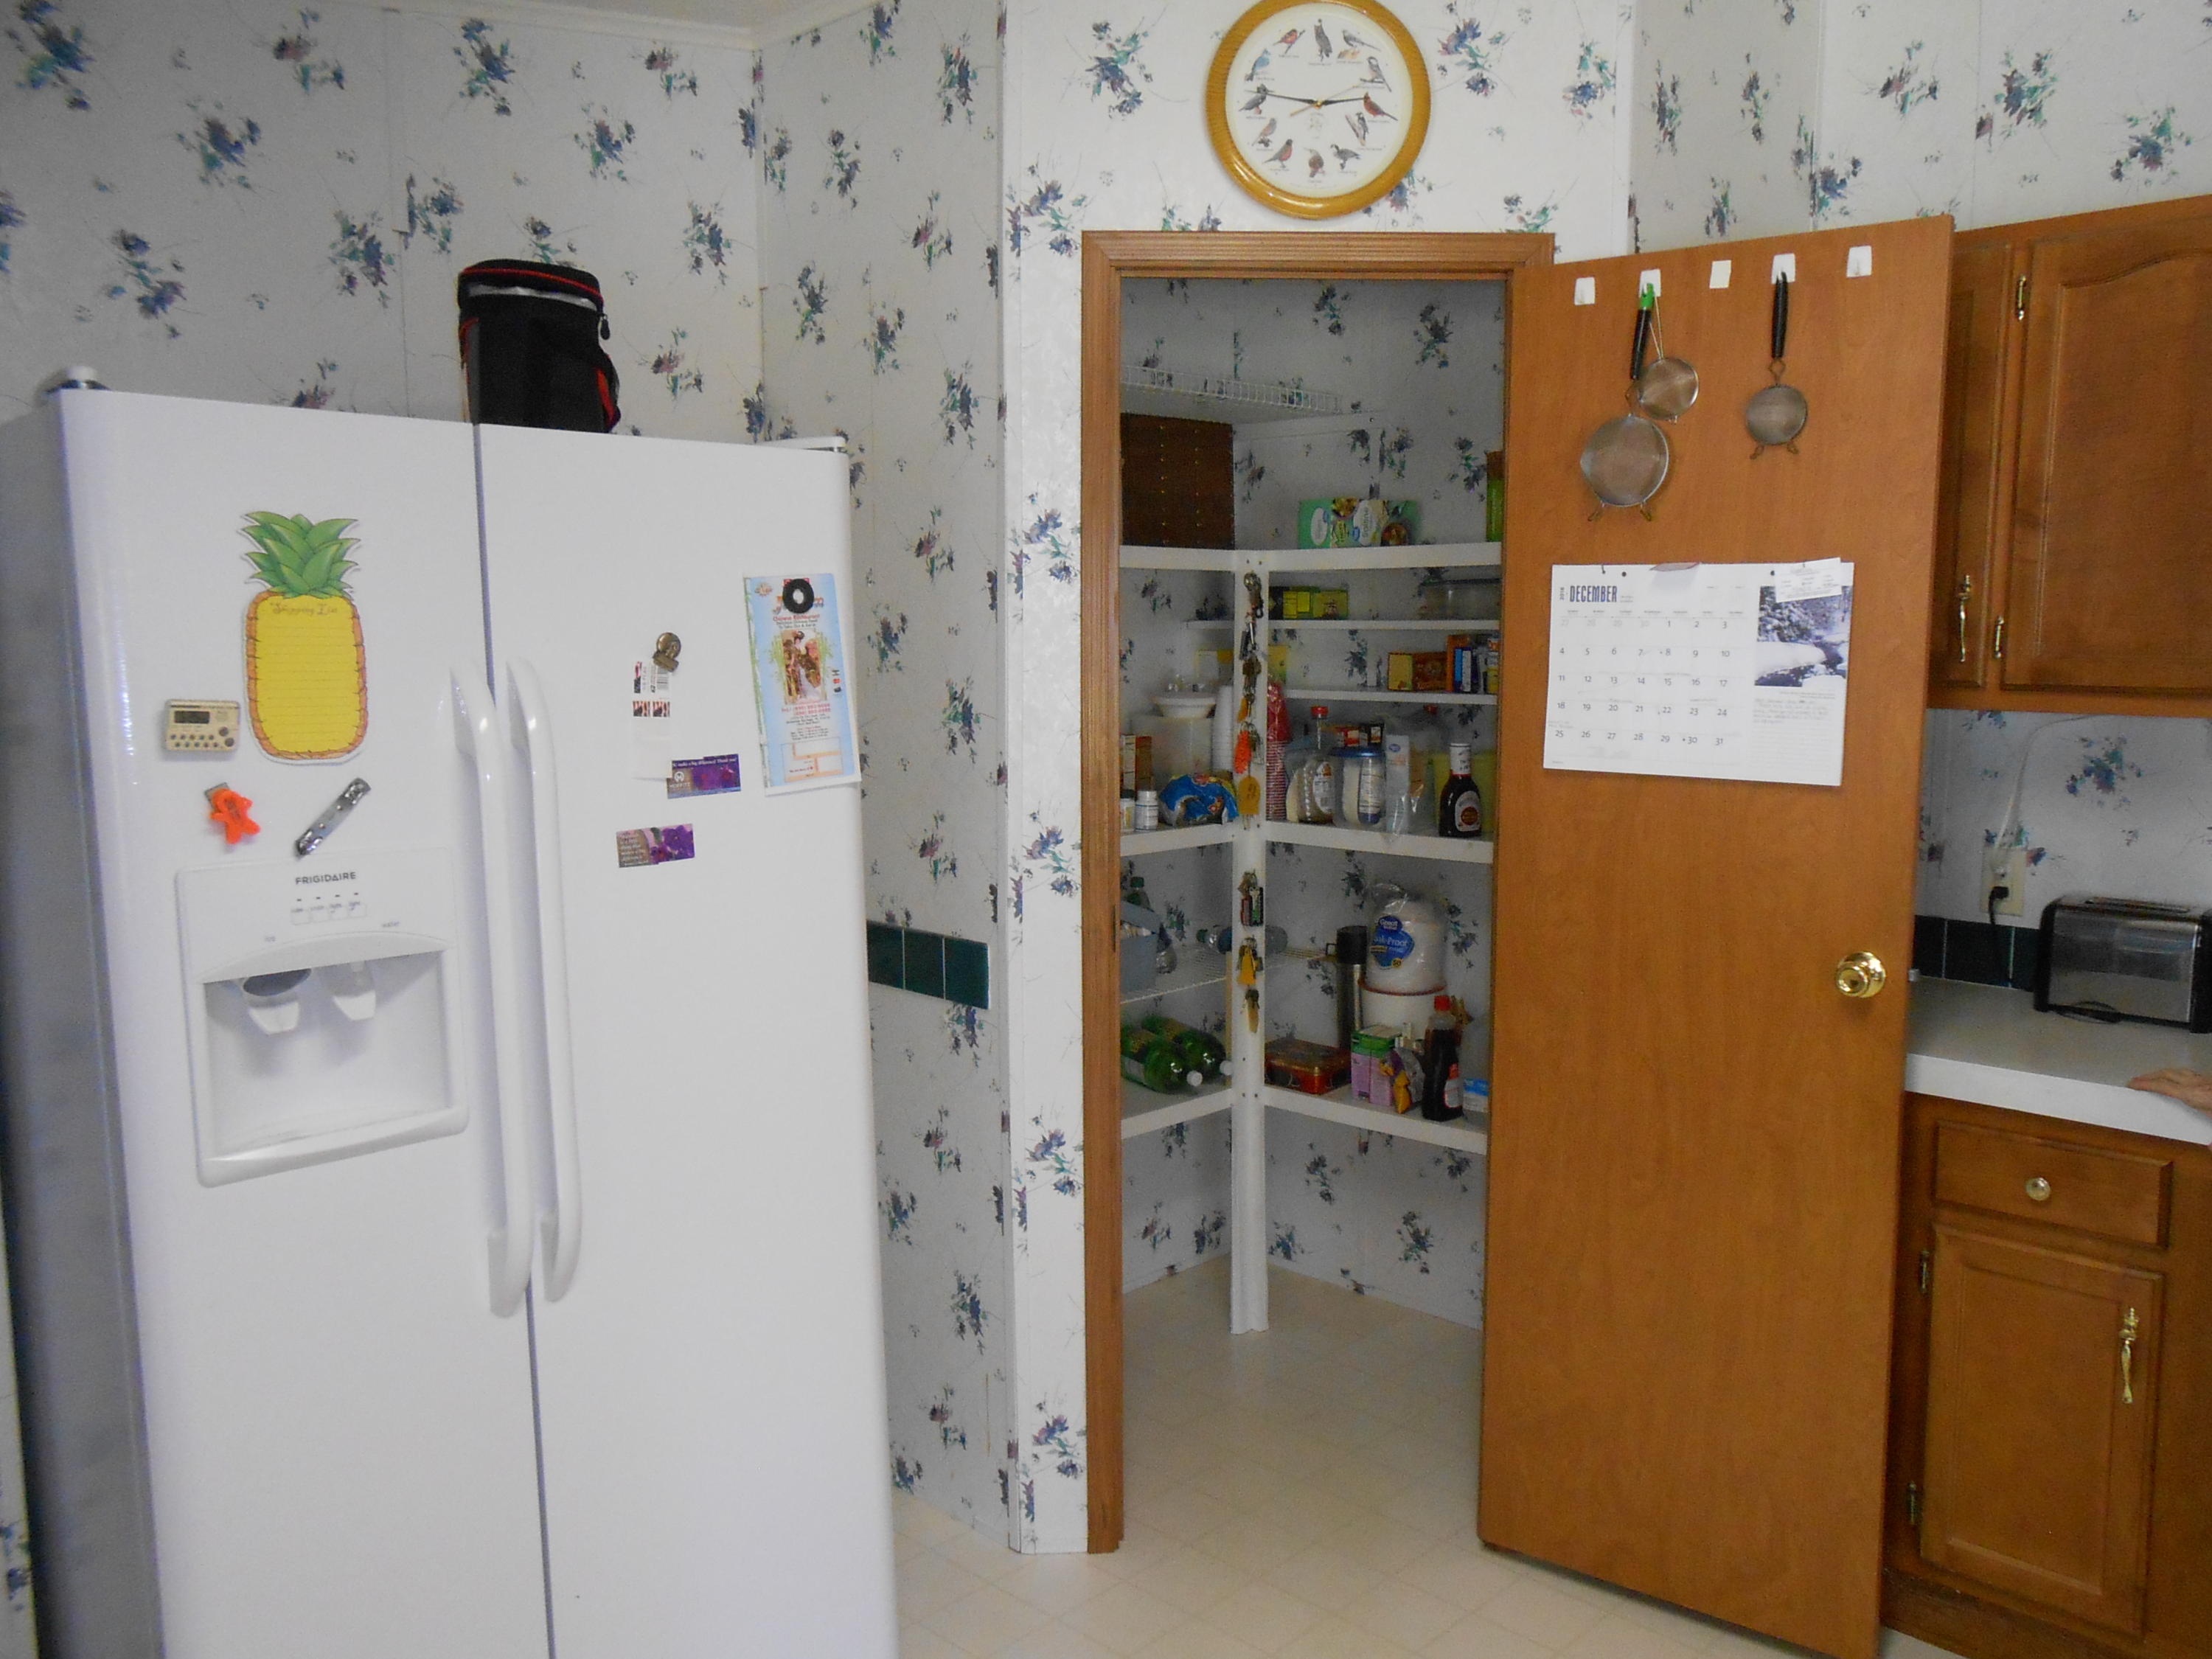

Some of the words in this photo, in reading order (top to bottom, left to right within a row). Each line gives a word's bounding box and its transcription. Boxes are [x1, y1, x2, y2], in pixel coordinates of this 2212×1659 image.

[1569, 585, 1618, 602] DECEMBER
[1666, 619, 1672, 627] 1
[1694, 620, 1700, 628] 2
[1722, 621, 1728, 630] 3
[1585, 647, 1590, 655] 5
[1611, 647, 1617, 655] 6
[1638, 648, 1644, 657] 7
[1665, 648, 1671, 656] 8
[1692, 650, 1699, 658] 9
[1721, 650, 1731, 658] 10
[1610, 676, 1618, 684] 13
[1637, 677, 1646, 685] 14
[1663, 678, 1672, 686] 15
[1691, 678, 1701, 686] 16
[1719, 679, 1728, 687] 17
[1557, 701, 1565, 709] 18
[1582, 703, 1591, 712] 19
[1635, 705, 1644, 713] 21
[1662, 706, 1672, 714] 22
[1689, 707, 1699, 716] 23
[1717, 708, 1728, 717] 24
[1555, 729, 1564, 738] 25
[1581, 730, 1591, 738] 26
[1633, 732, 1644, 741] 28
[1660, 734, 1671, 743] 29
[1687, 736, 1698, 745] 30
[1714, 737, 1724, 746] 31
[295, 871, 357, 886] FRIGIDAIRE
